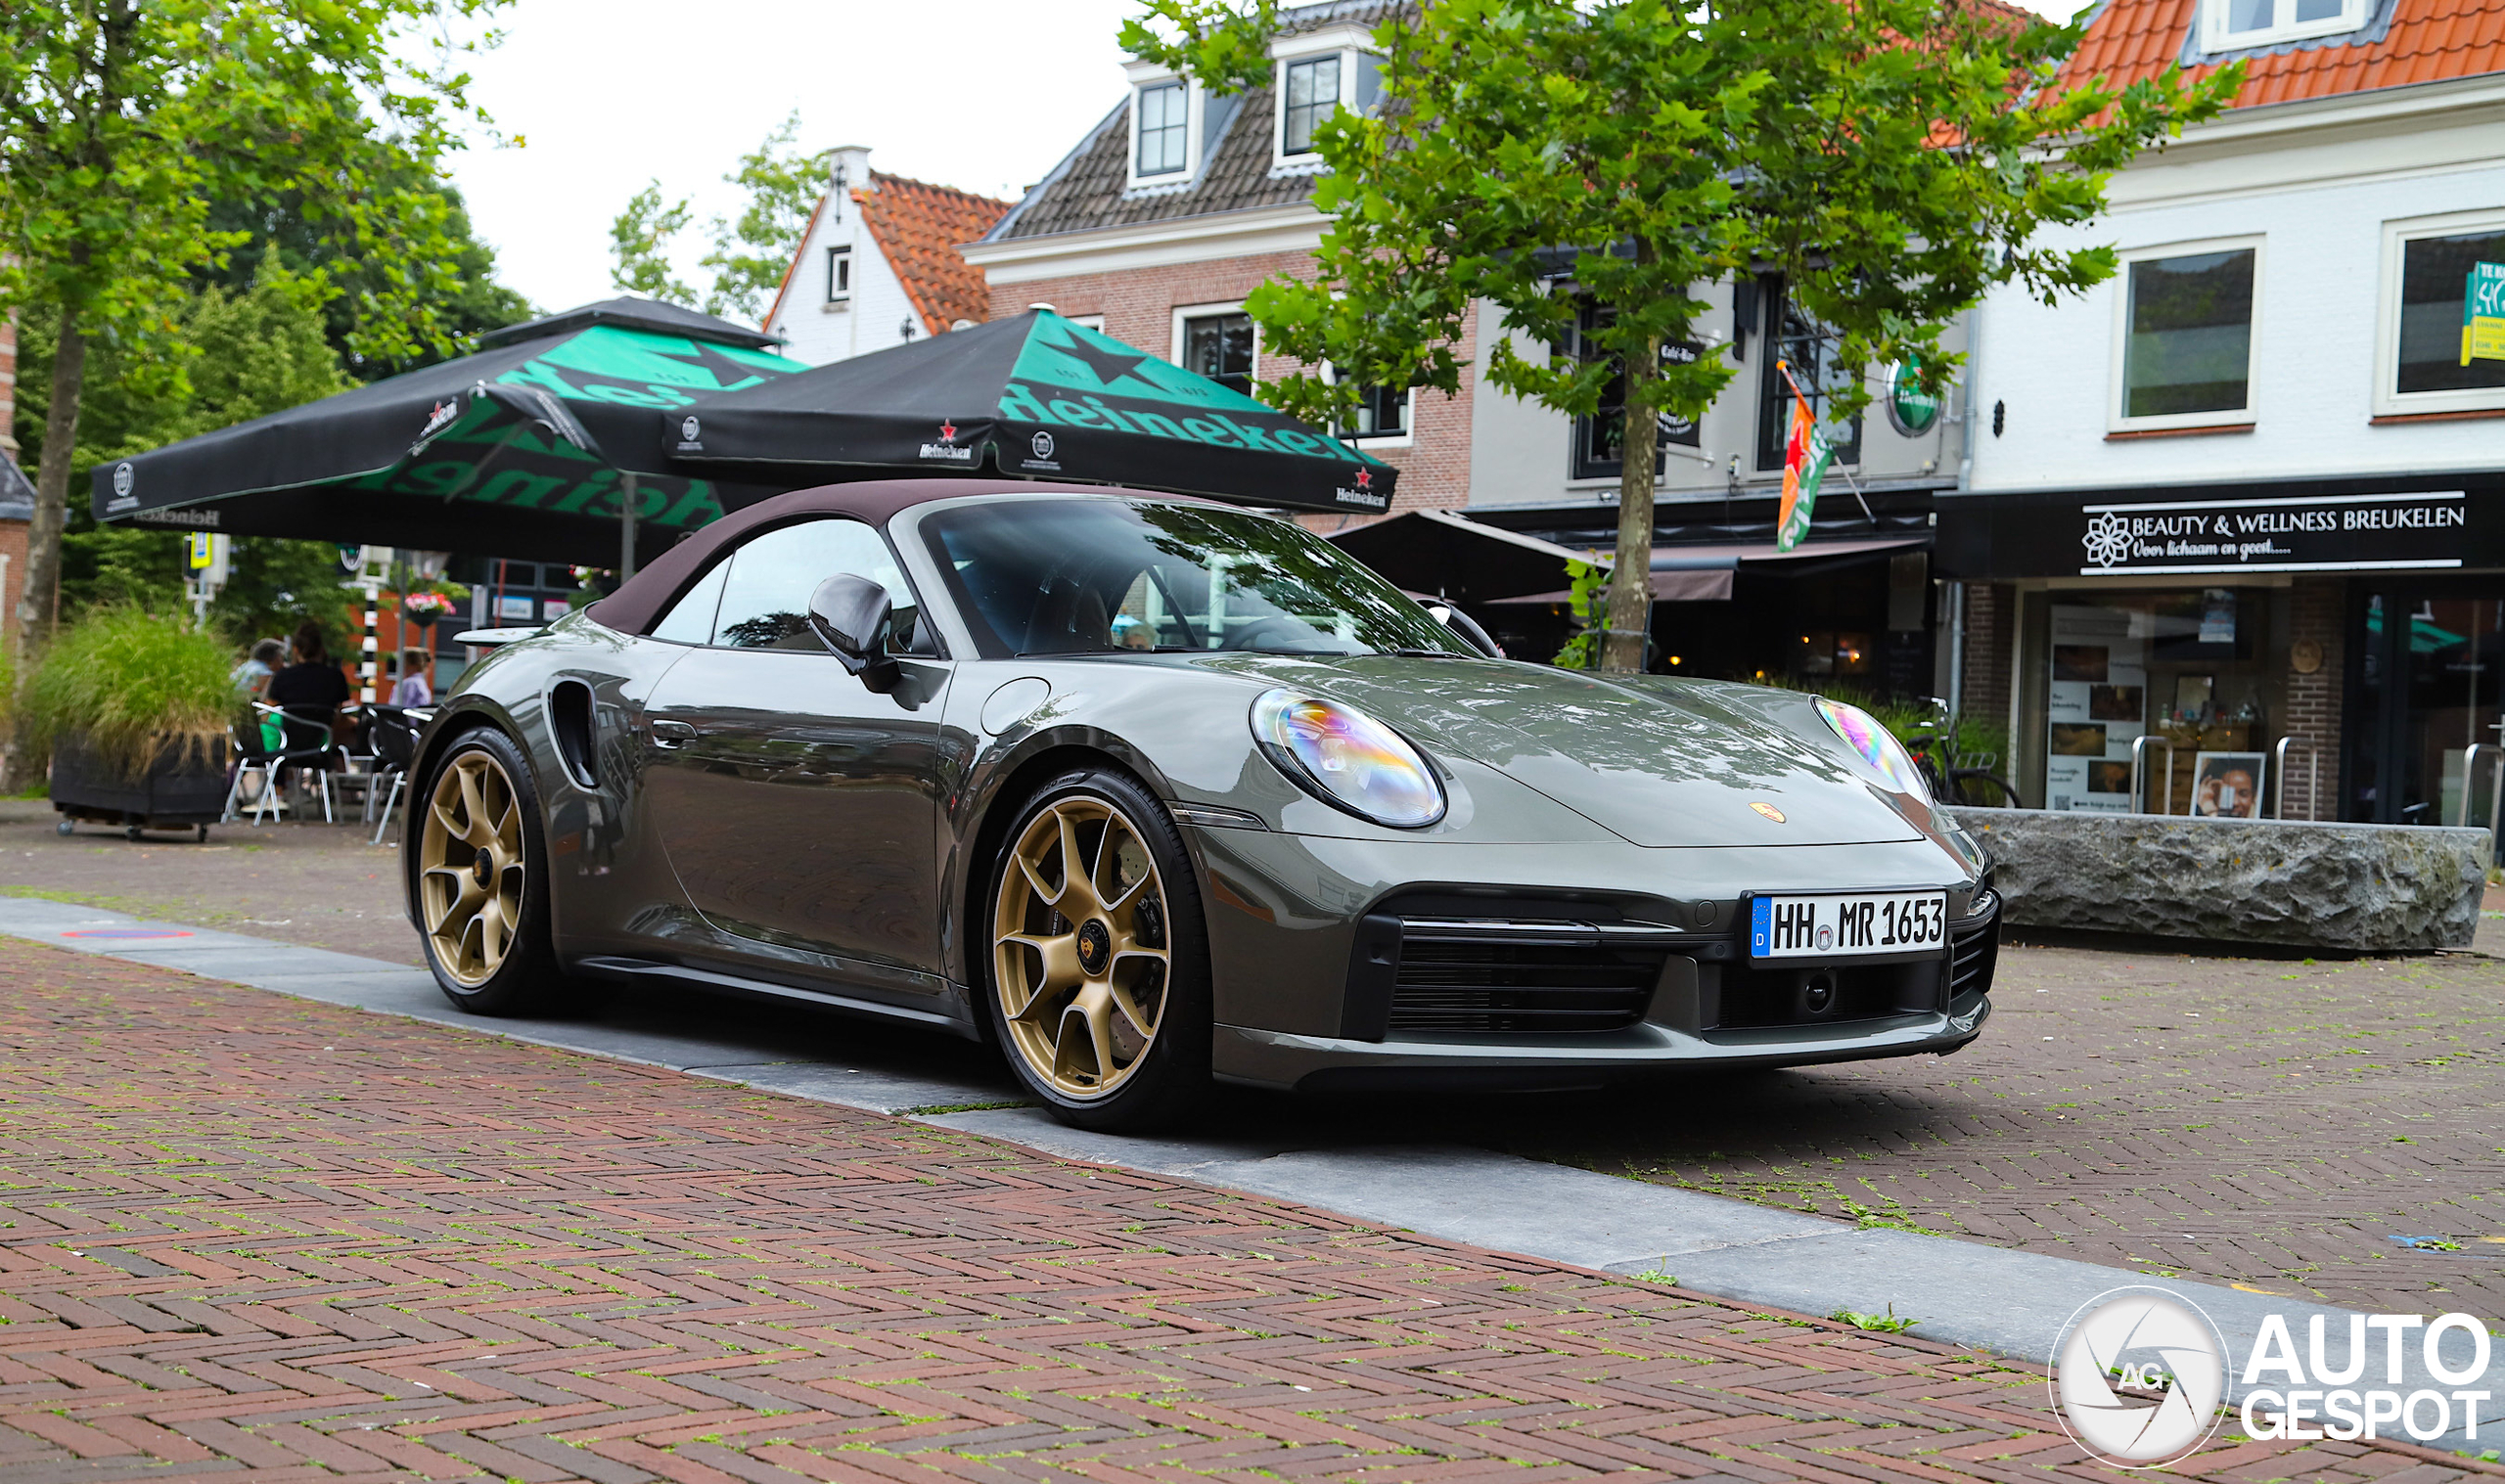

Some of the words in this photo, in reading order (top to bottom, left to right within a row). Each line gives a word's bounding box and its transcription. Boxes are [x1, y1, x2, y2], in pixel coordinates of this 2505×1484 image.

[919, 443, 973, 461] Heineken
[1336, 487, 1387, 508] Heineken
[2132, 515, 2209, 537] BEAUTY
[2213, 515, 2235, 538] &
[2235, 510, 2337, 534] WELLNESS
[2343, 506, 2465, 530] BREUKELEN
[2132, 538, 2164, 558] Voor
[2166, 539, 2219, 557] lichaam
[2220, 543, 2237, 555] en
[1774, 903, 1815, 949] HH
[1839, 901, 1875, 947] MR
[1882, 898, 1943, 945] 1653
[1755, 932, 1764, 947] D
